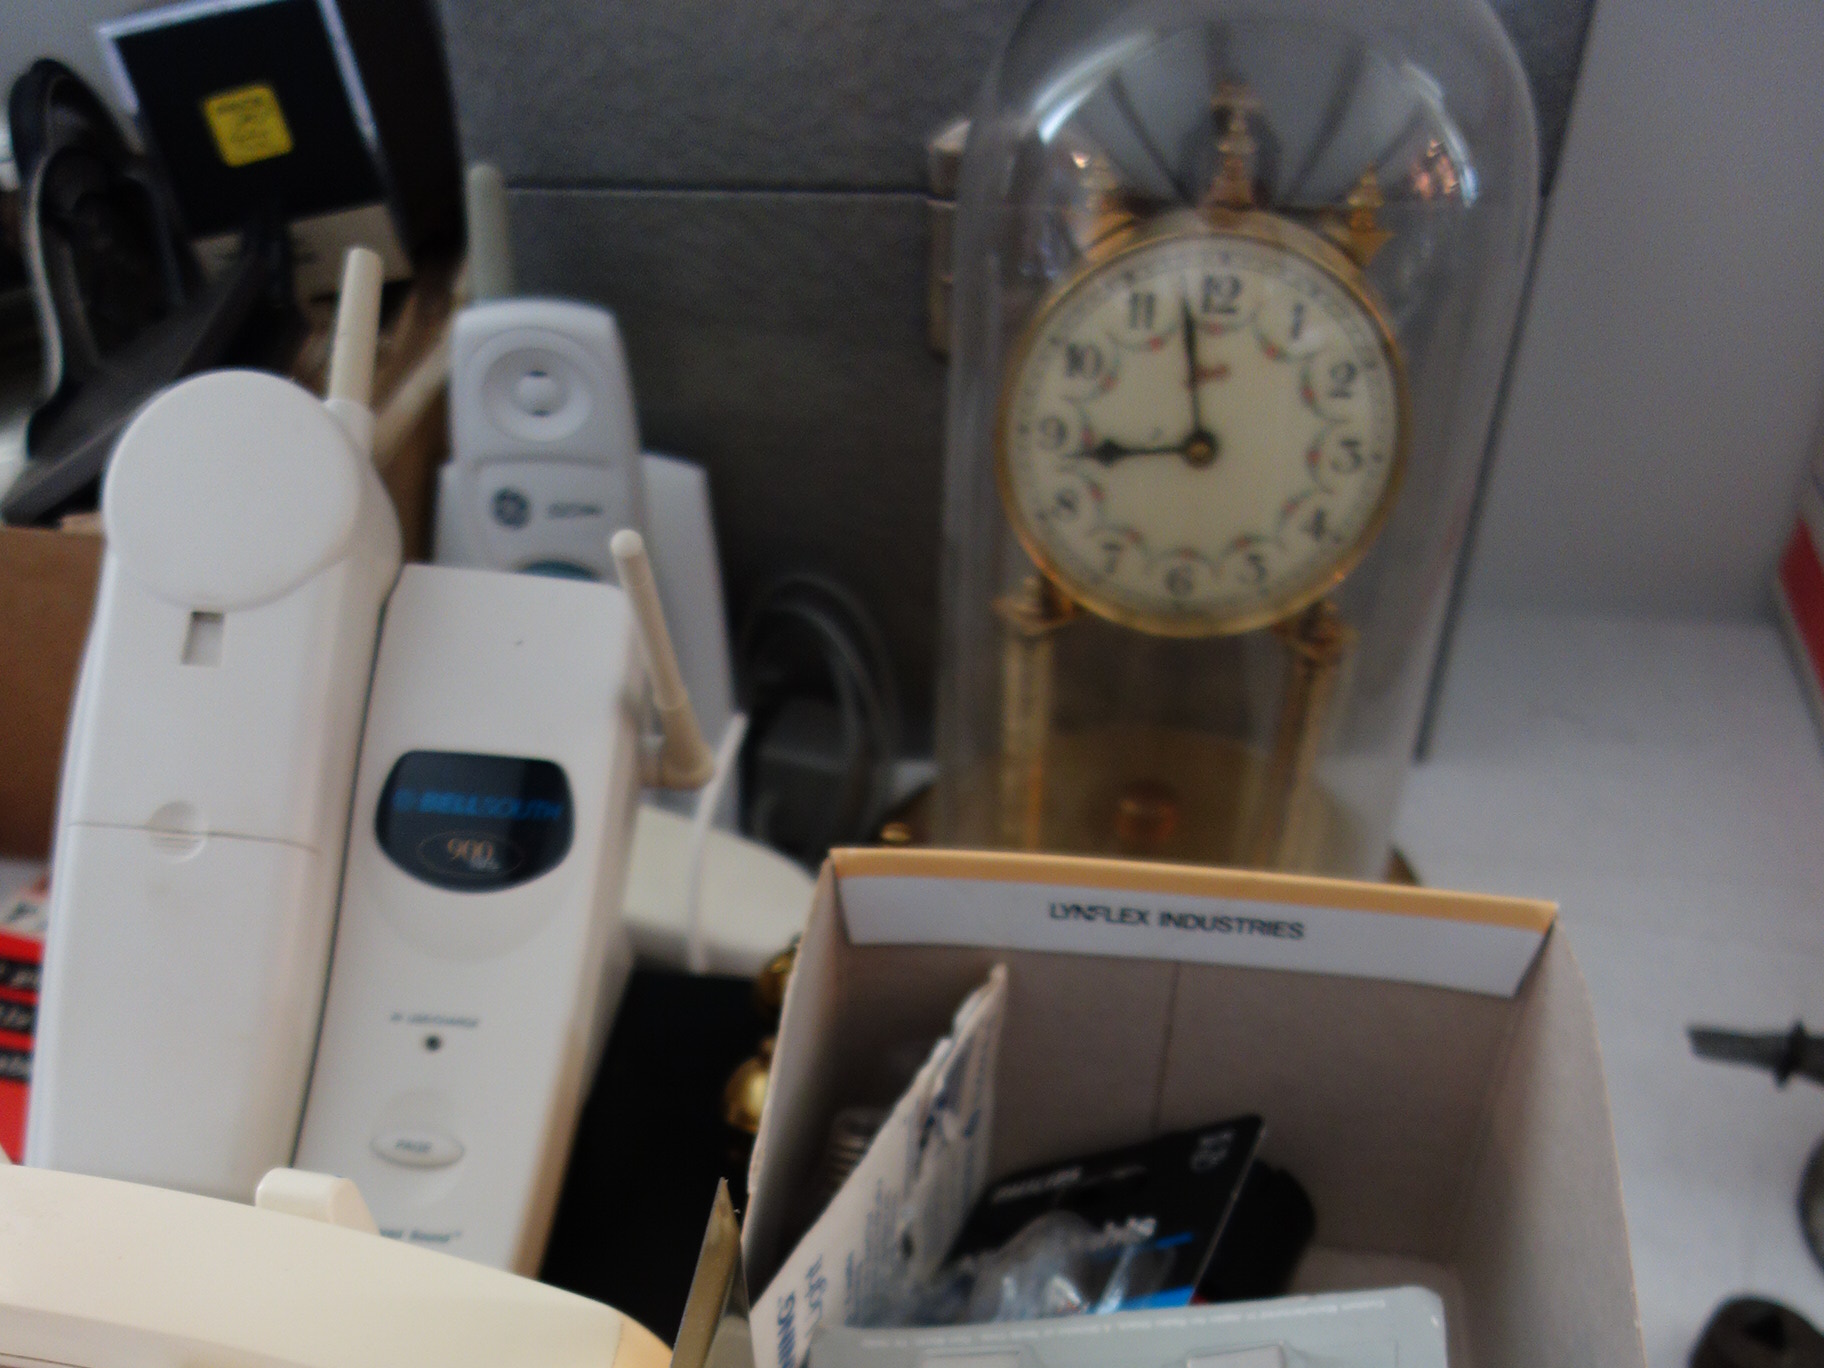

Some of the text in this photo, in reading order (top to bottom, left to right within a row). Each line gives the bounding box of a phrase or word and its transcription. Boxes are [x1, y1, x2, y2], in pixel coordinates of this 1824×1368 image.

[1129, 292, 1155, 331] 11
[1201, 274, 1242, 315] 12
[1291, 303, 1305, 341] 1
[1065, 343, 1101, 380] 10
[1329, 360, 1357, 399] 2
[1039, 415, 1068, 451] 9
[1331, 437, 1363, 474] 3
[1055, 488, 1079, 521] 8
[1303, 507, 1326, 541] 4
[1101, 540, 1122, 573] 7
[1239, 553, 1267, 584] 5
[1164, 564, 1194, 596] 6
[1048, 902, 1305, 941] LYNFLEX INDUSTRIES
